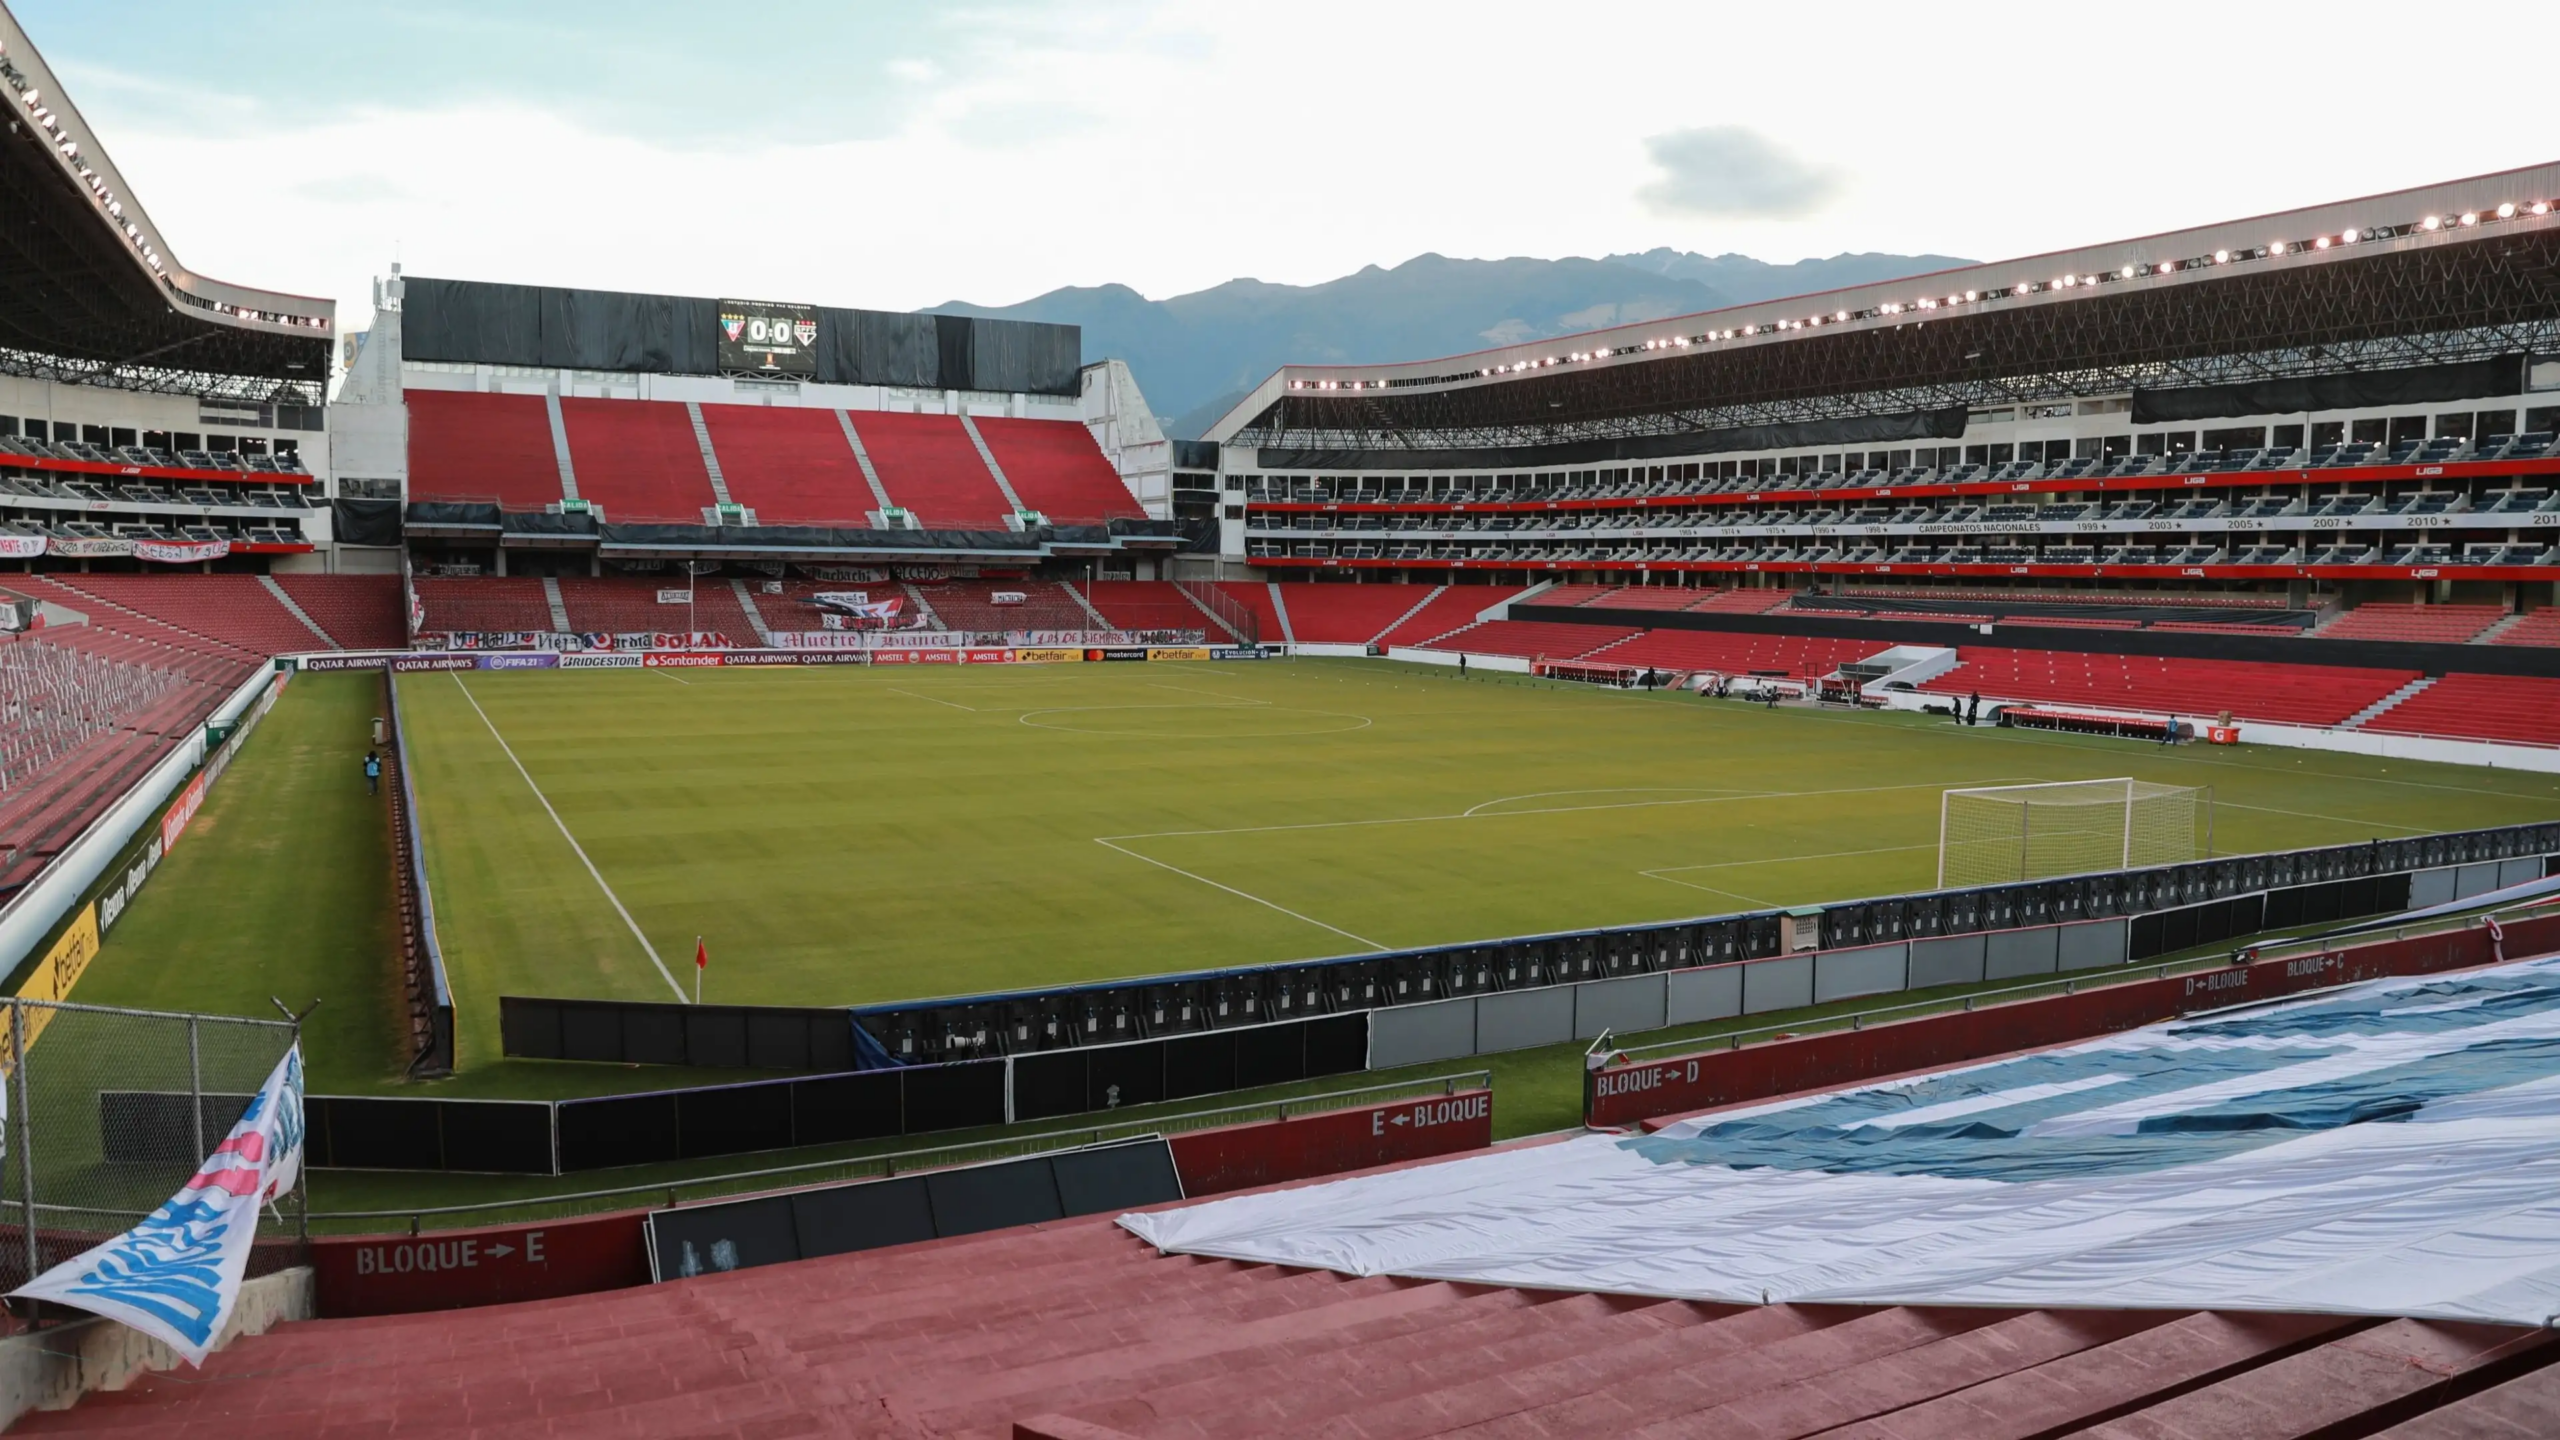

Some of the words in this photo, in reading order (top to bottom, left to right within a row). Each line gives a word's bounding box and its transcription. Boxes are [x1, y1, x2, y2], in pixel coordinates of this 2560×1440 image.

[2416, 466, 2443, 475] LIGA
[2077, 522, 2098, 531] 1999
[2149, 522, 2172, 530] 2003
[2227, 520, 2253, 529] 2005
[2313, 519, 2340, 528] 2007
[2407, 517, 2438, 527] 2010
[1864, 526, 1881, 534] 1998
[1918, 524, 1982, 533] CAMPEONATOS
[1984, 523, 2041, 532] NACIONALES
[2011, 566, 2028, 574] LIGA
[2182, 567, 2203, 576] LIGA
[2411, 568, 2438, 579] LIGA
[725, 655, 756, 664] QATAR
[758, 654, 798, 663] AIRWAYS
[802, 655, 832, 664] QATAR
[835, 654, 873, 663] AIRWAYS
[972, 653, 998, 661] AMSTEL
[1031, 651, 1067, 661] betfair
[1106, 651, 1144, 659] mastercard
[1161, 650, 1195, 660] betfair
[310, 661, 344, 670] QATAR
[396, 662, 430, 670] QATAR
[432, 659, 472, 668] AIRWAYS
[562, 656, 641, 666] BRIDGESTONE
[660, 655, 720, 666] Santander
[2214, 730, 2224, 741] G
[2287, 956, 2324, 977] BLOQUE
[2337, 952, 2344, 969] C
[2186, 968, 2194, 996] D
[2208, 970, 2248, 991] BLOQUE
[1597, 1066, 1662, 1097] BLOQUE
[1686, 1061, 1699, 1083] D
[1373, 1111, 1384, 1136] E
[1414, 1096, 1488, 1128] BLOQUE
[356, 1239, 478, 1275] BLOQUE
[526, 1232, 544, 1262] E
